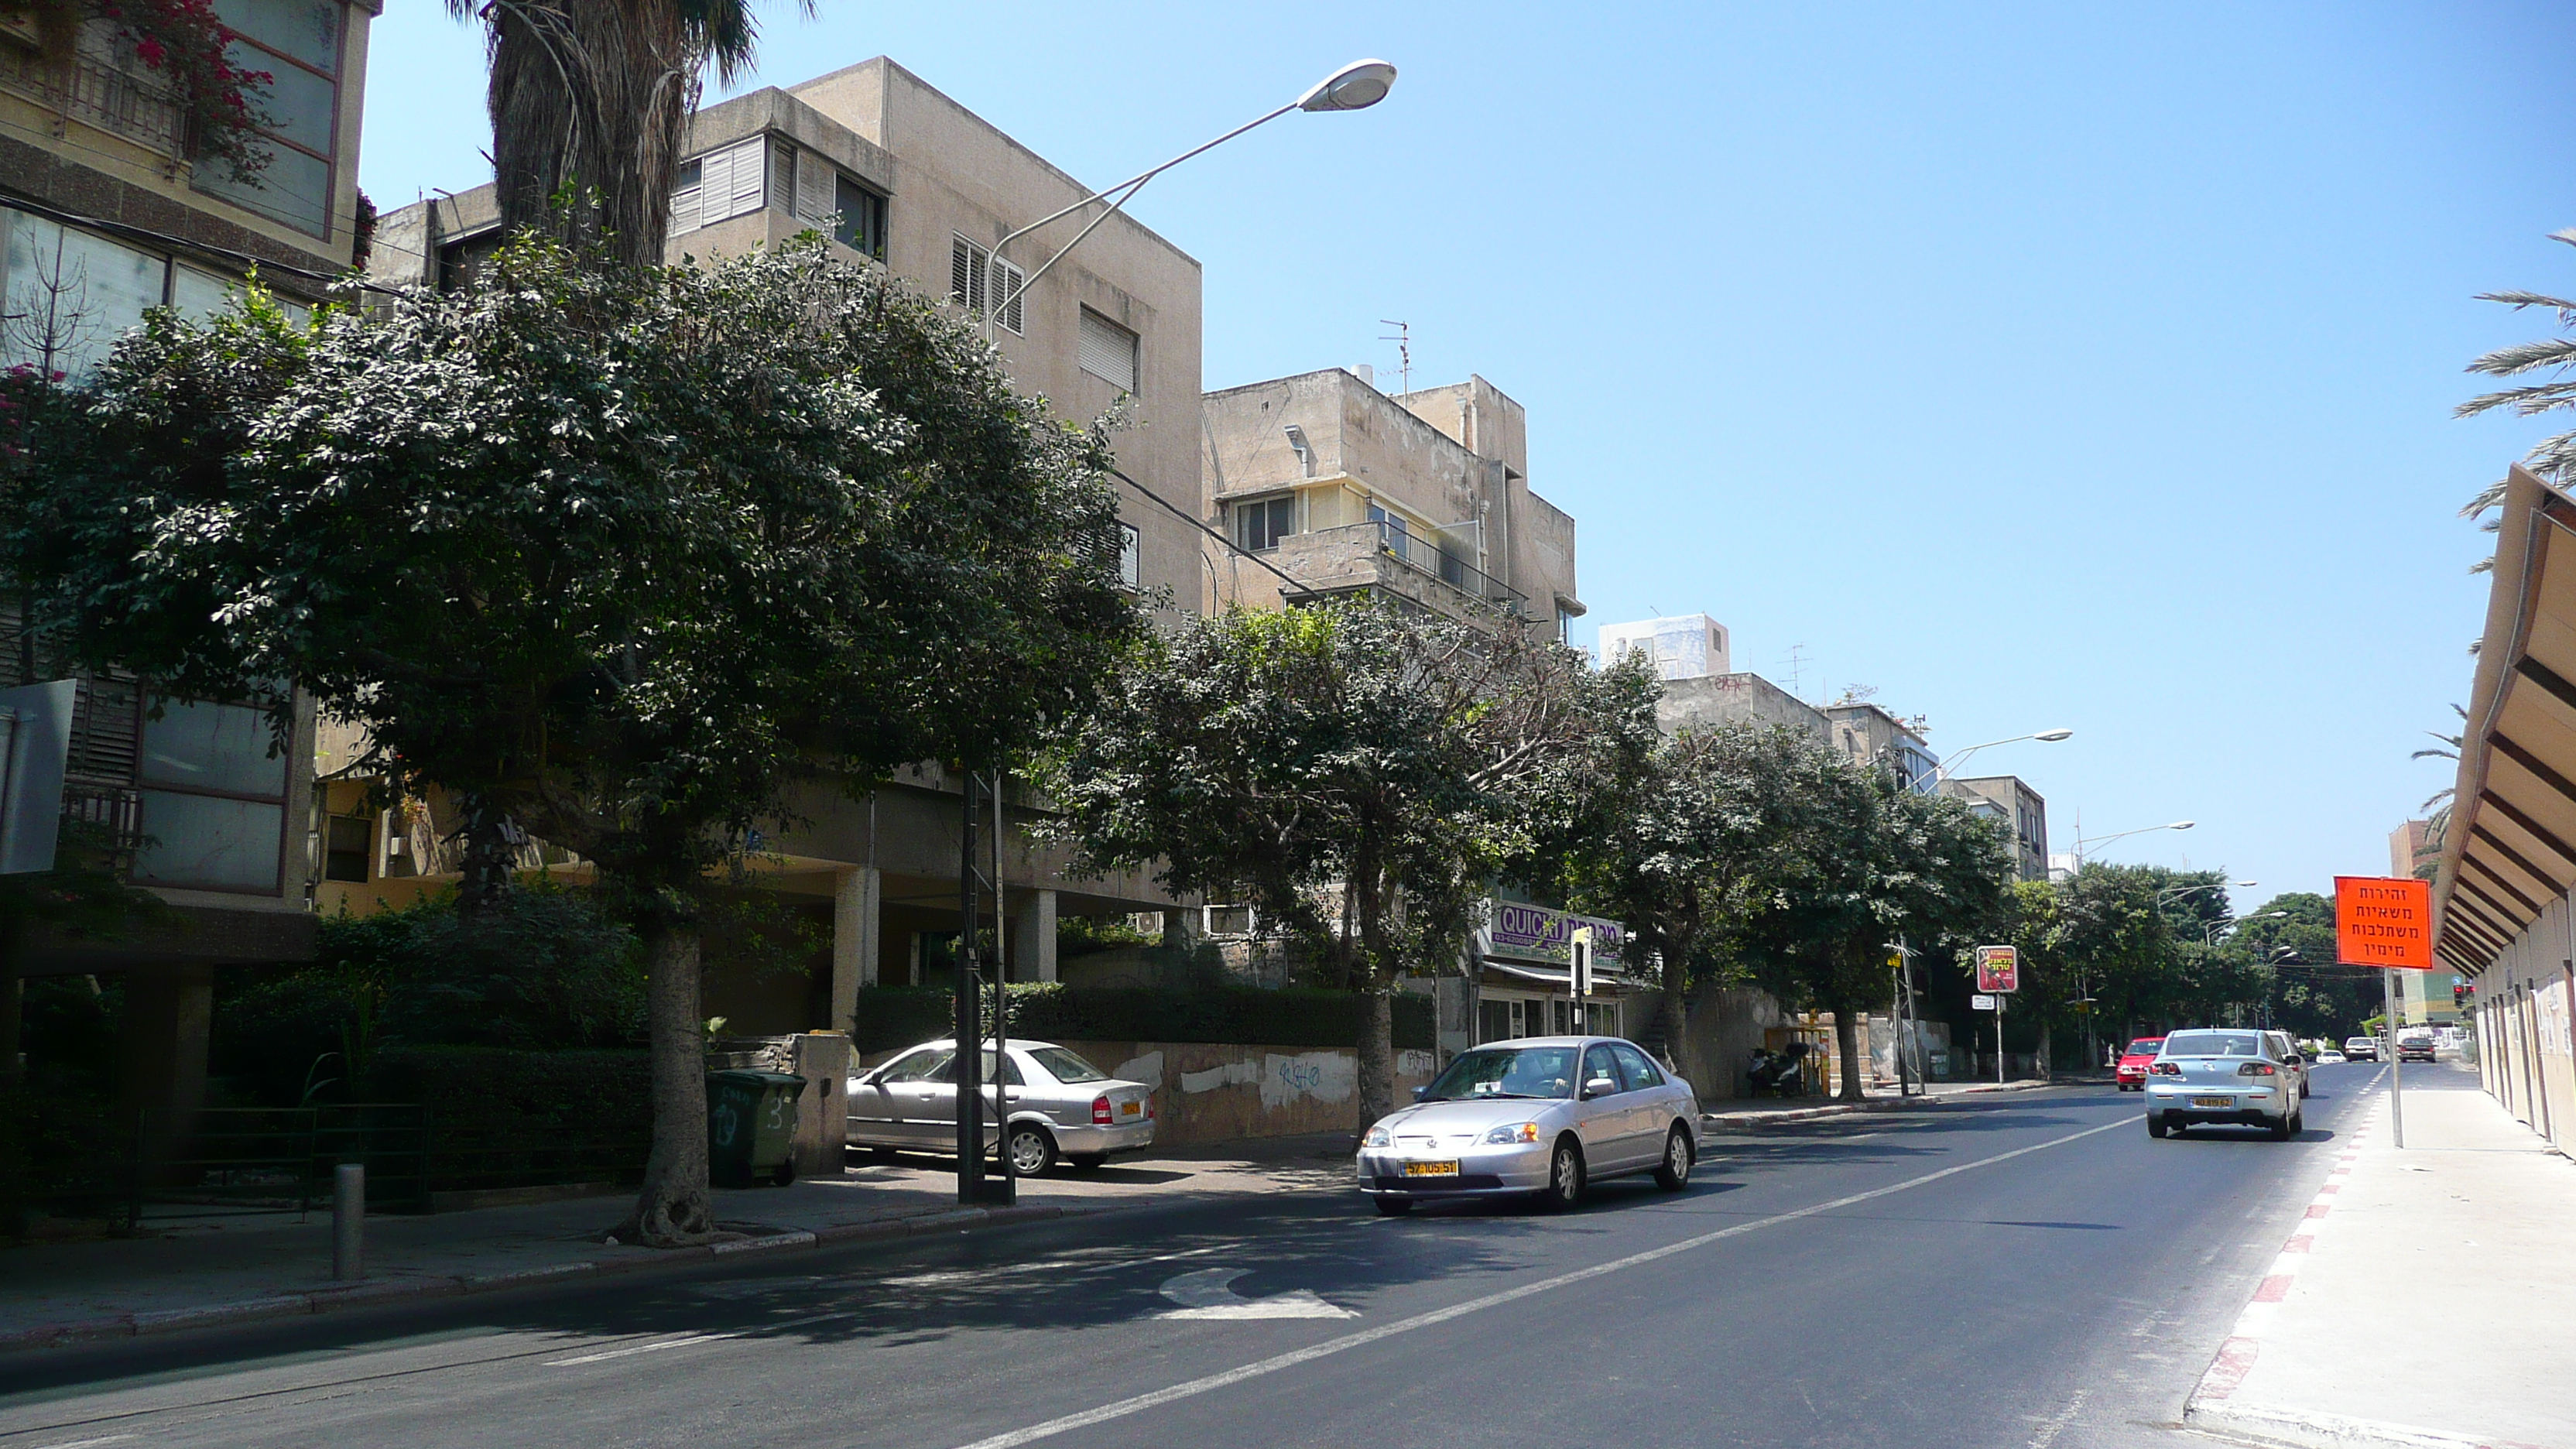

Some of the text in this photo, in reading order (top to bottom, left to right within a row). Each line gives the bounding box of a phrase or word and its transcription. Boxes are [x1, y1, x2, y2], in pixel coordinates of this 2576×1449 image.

[2359, 887, 2406, 901] זהירות
[2356, 906, 2413, 920] משאיות
[2352, 923, 2419, 939] משתלבות
[2364, 943, 2405, 957] מימין
